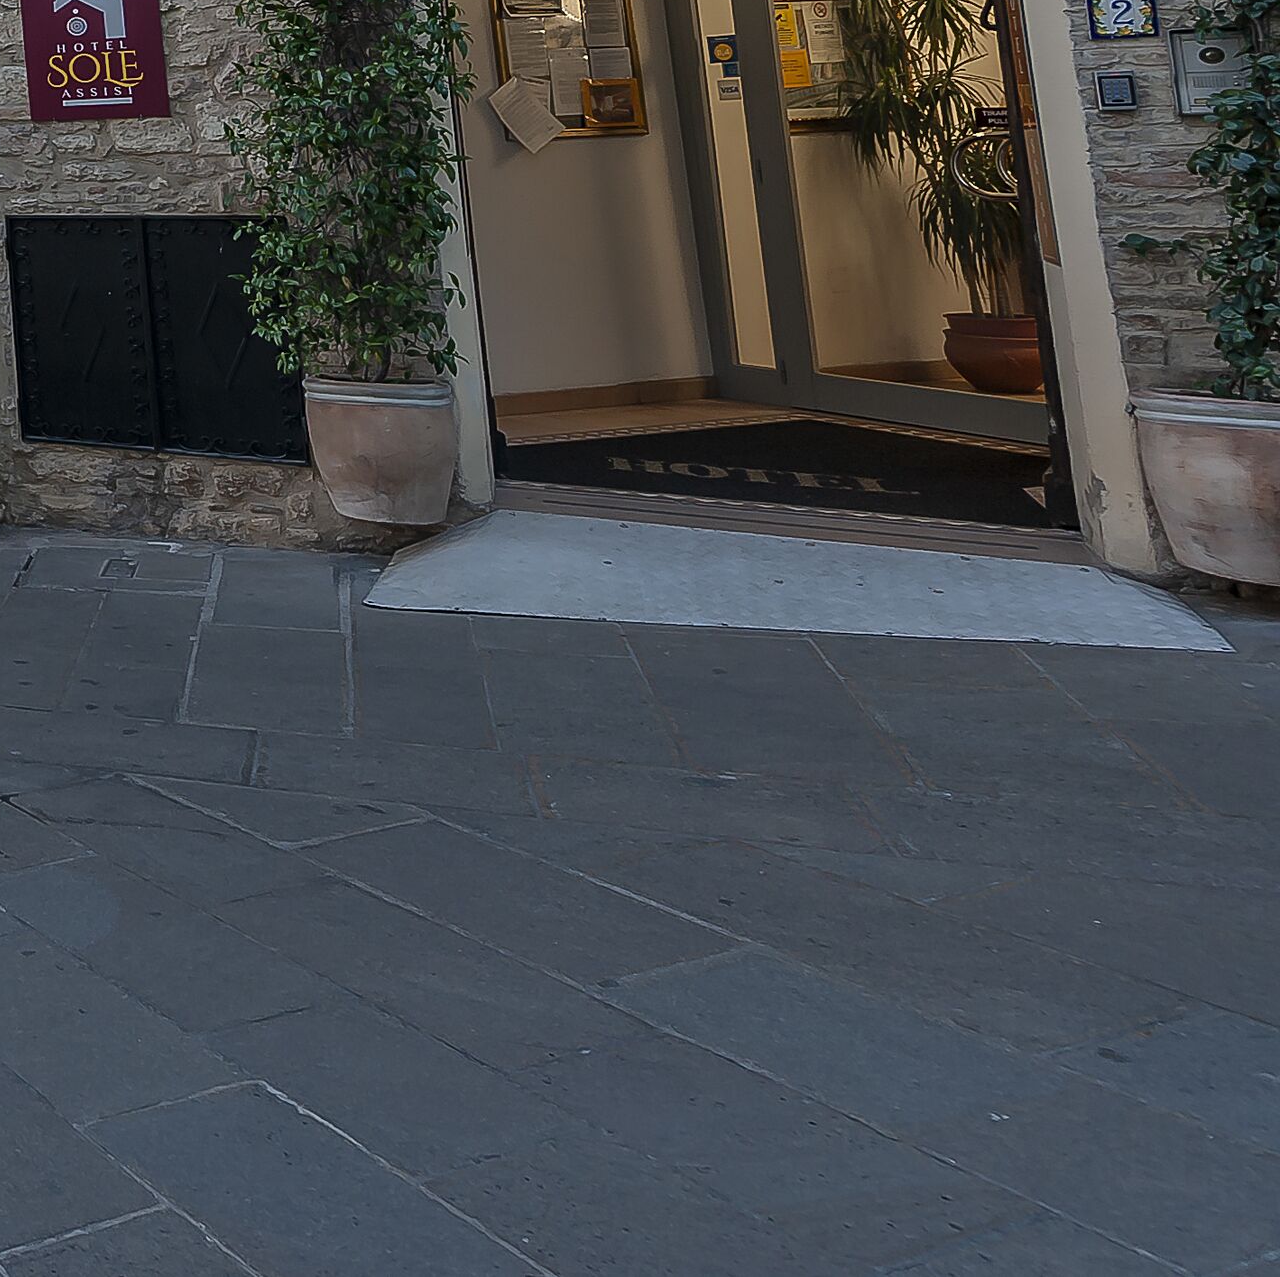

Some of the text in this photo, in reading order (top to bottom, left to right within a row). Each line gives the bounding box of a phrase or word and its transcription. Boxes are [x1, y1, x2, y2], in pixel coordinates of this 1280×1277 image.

[1111, 0, 1134, 25] 2
[57, 41, 127, 53] HOTEL
[47, 51, 144, 88] SOLE
[62, 86, 133, 98] ASSISI
[720, 86, 739, 94] VISA
[606, 456, 921, 495] HOTEL
